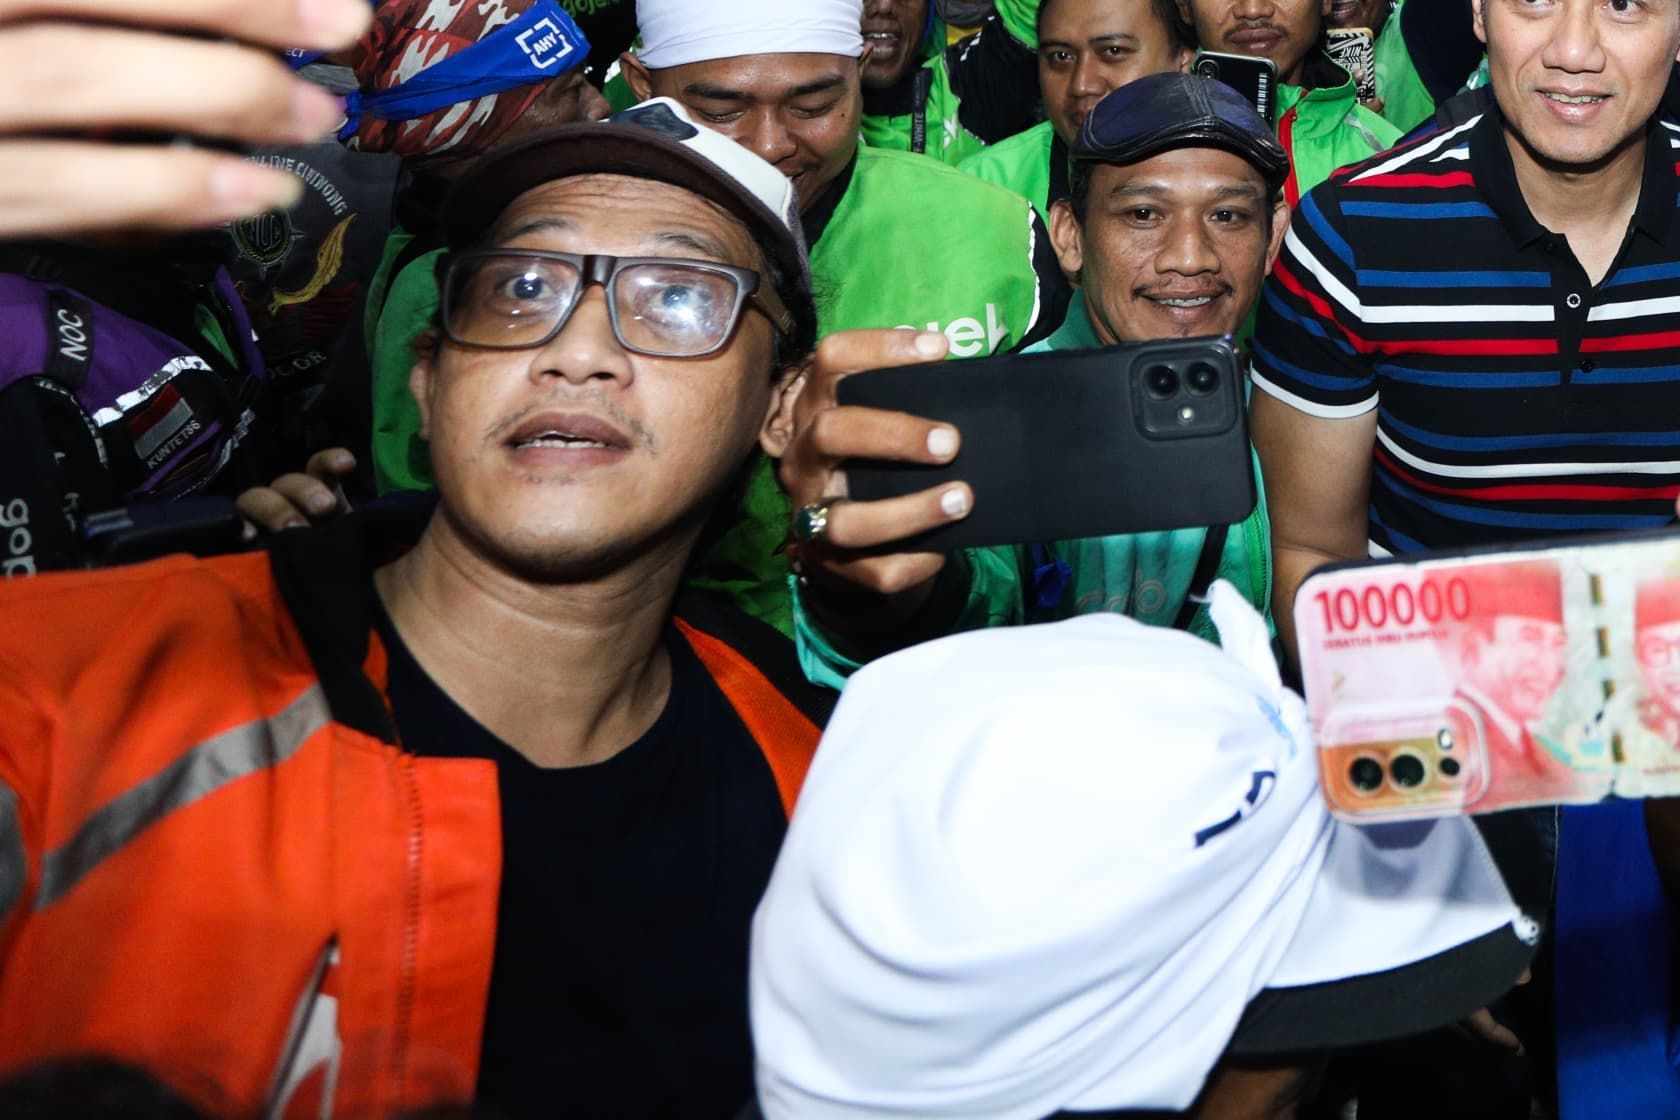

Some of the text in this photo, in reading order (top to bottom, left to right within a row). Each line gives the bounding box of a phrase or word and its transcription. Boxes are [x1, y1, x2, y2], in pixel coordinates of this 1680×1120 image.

[532, 31, 559, 56] AHY
[57, 308, 90, 361] NOC
[1314, 577, 1471, 634] 100000
